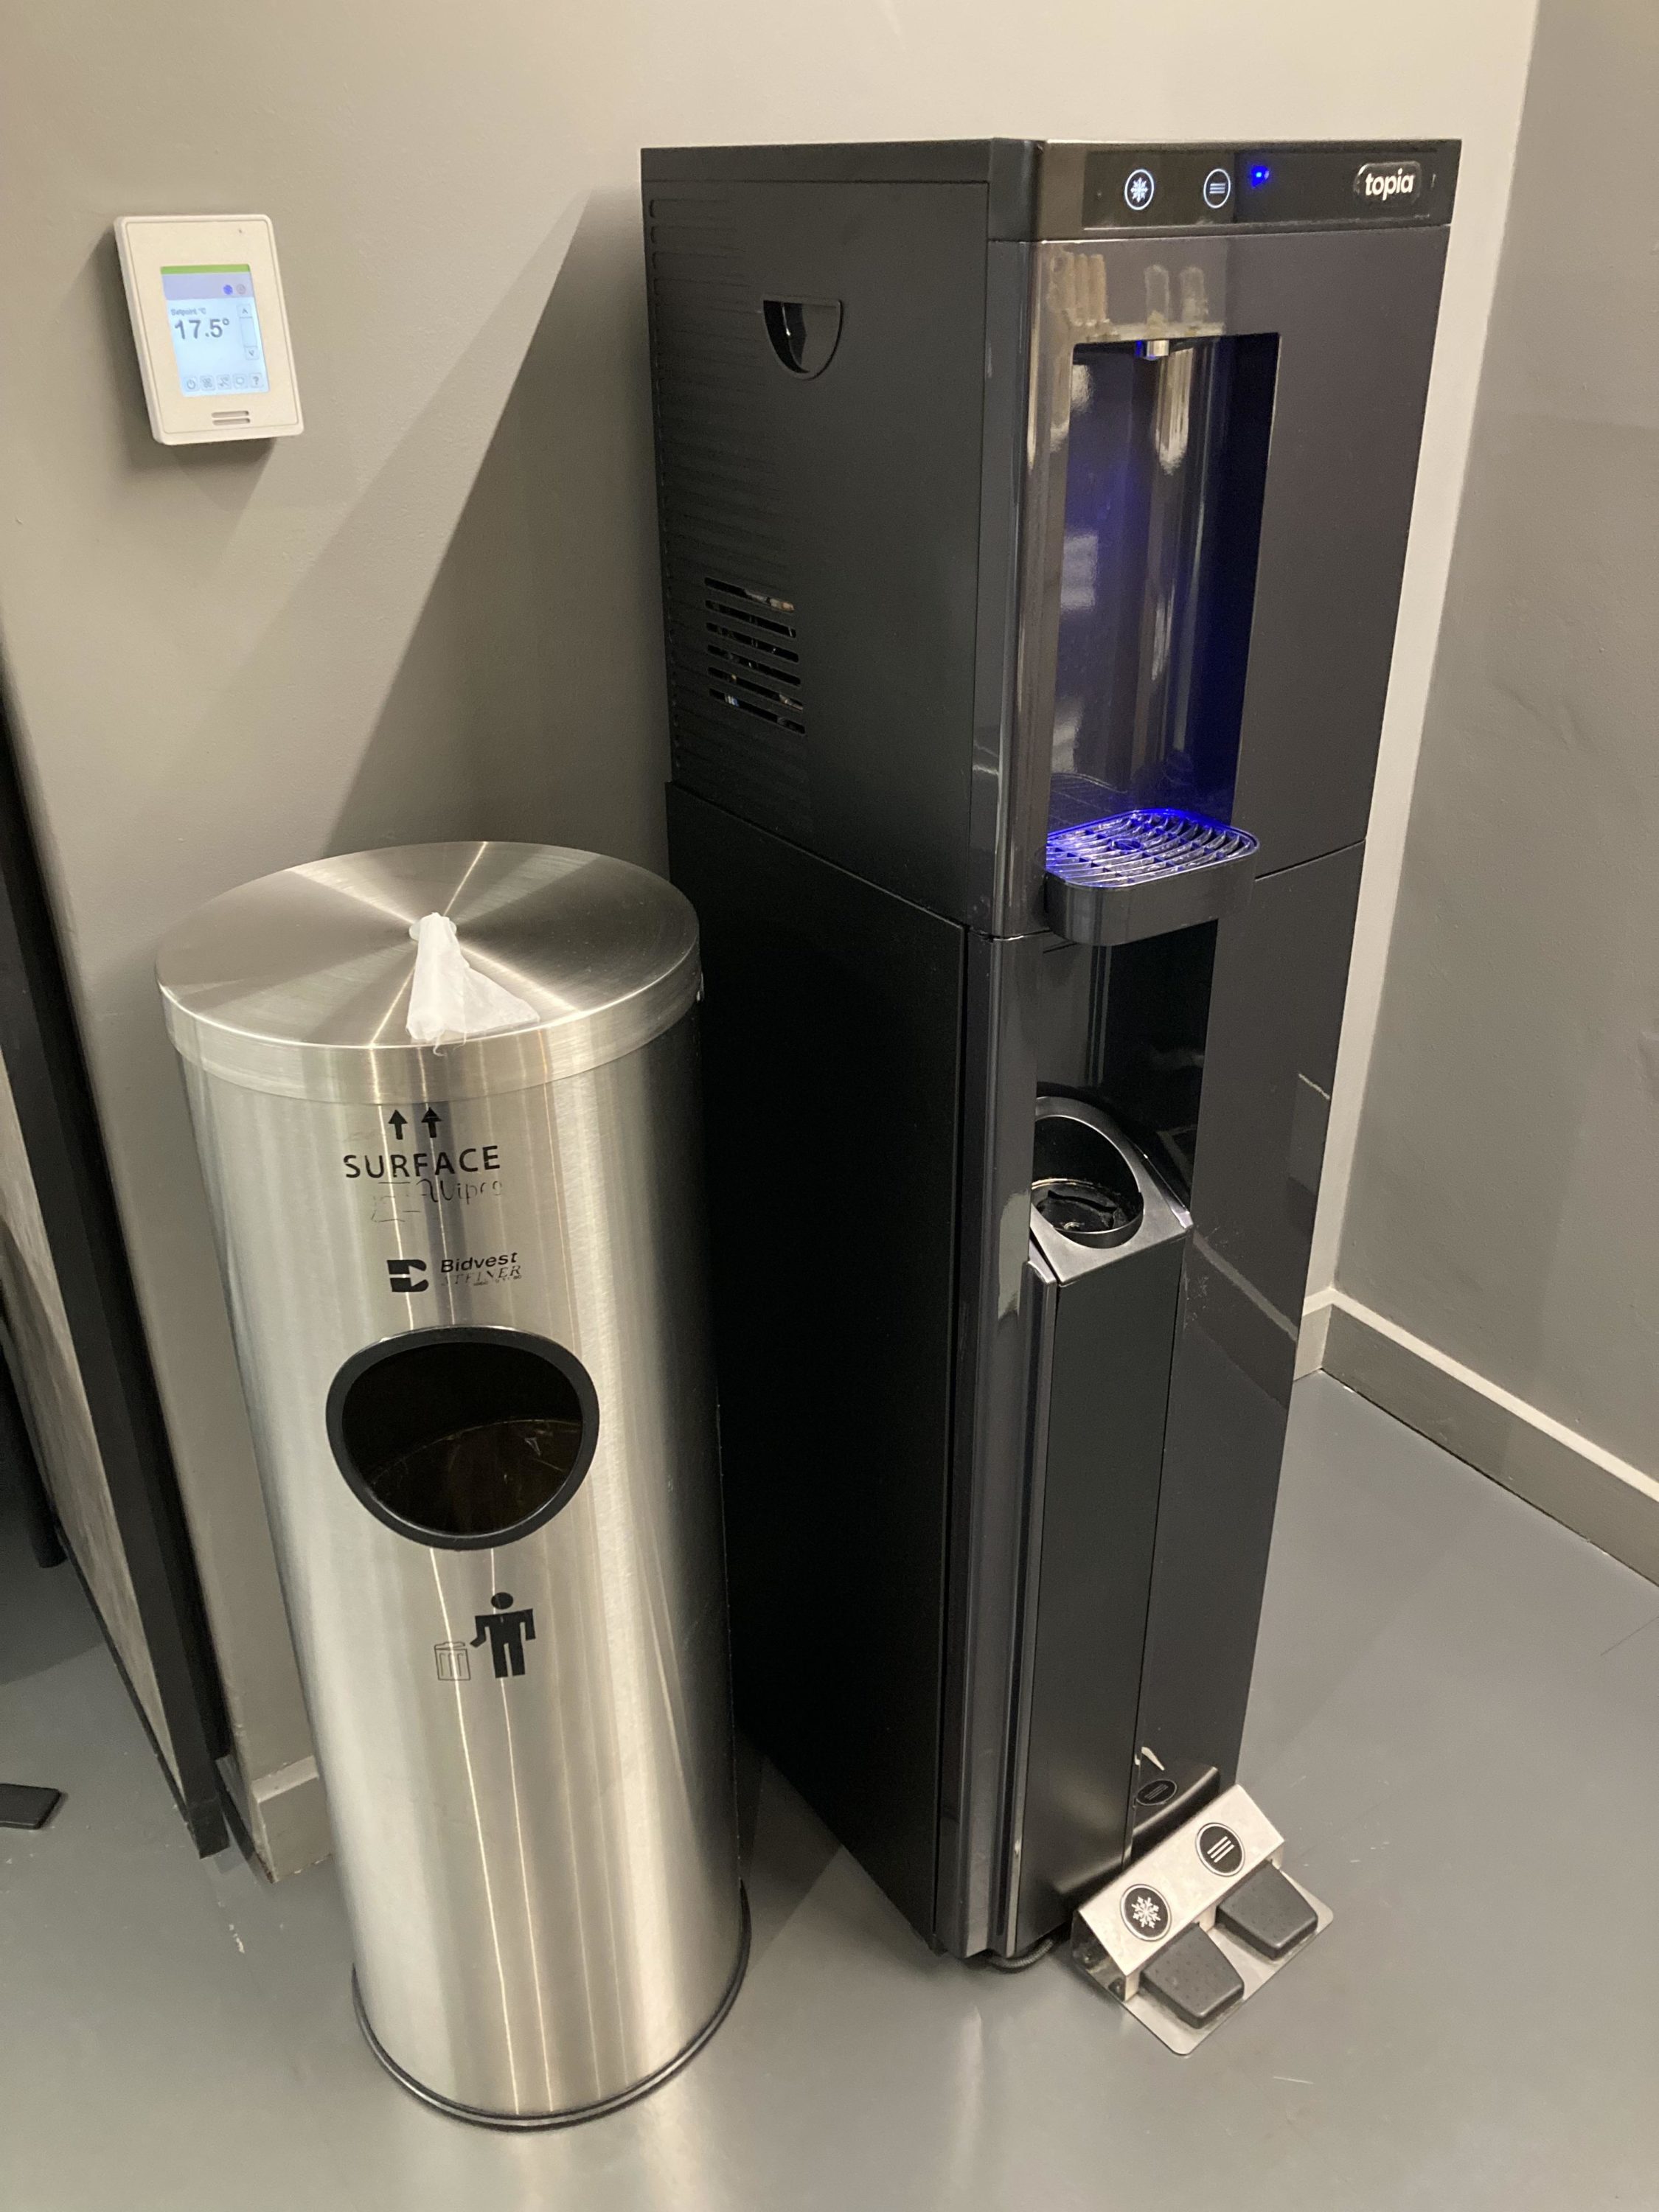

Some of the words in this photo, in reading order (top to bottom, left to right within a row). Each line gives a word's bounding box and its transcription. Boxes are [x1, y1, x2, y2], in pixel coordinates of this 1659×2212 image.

[1365, 168, 1415, 201] topia
[343, 1145, 501, 1178] SURFACE
[441, 1252, 518, 1273] Bidvest
